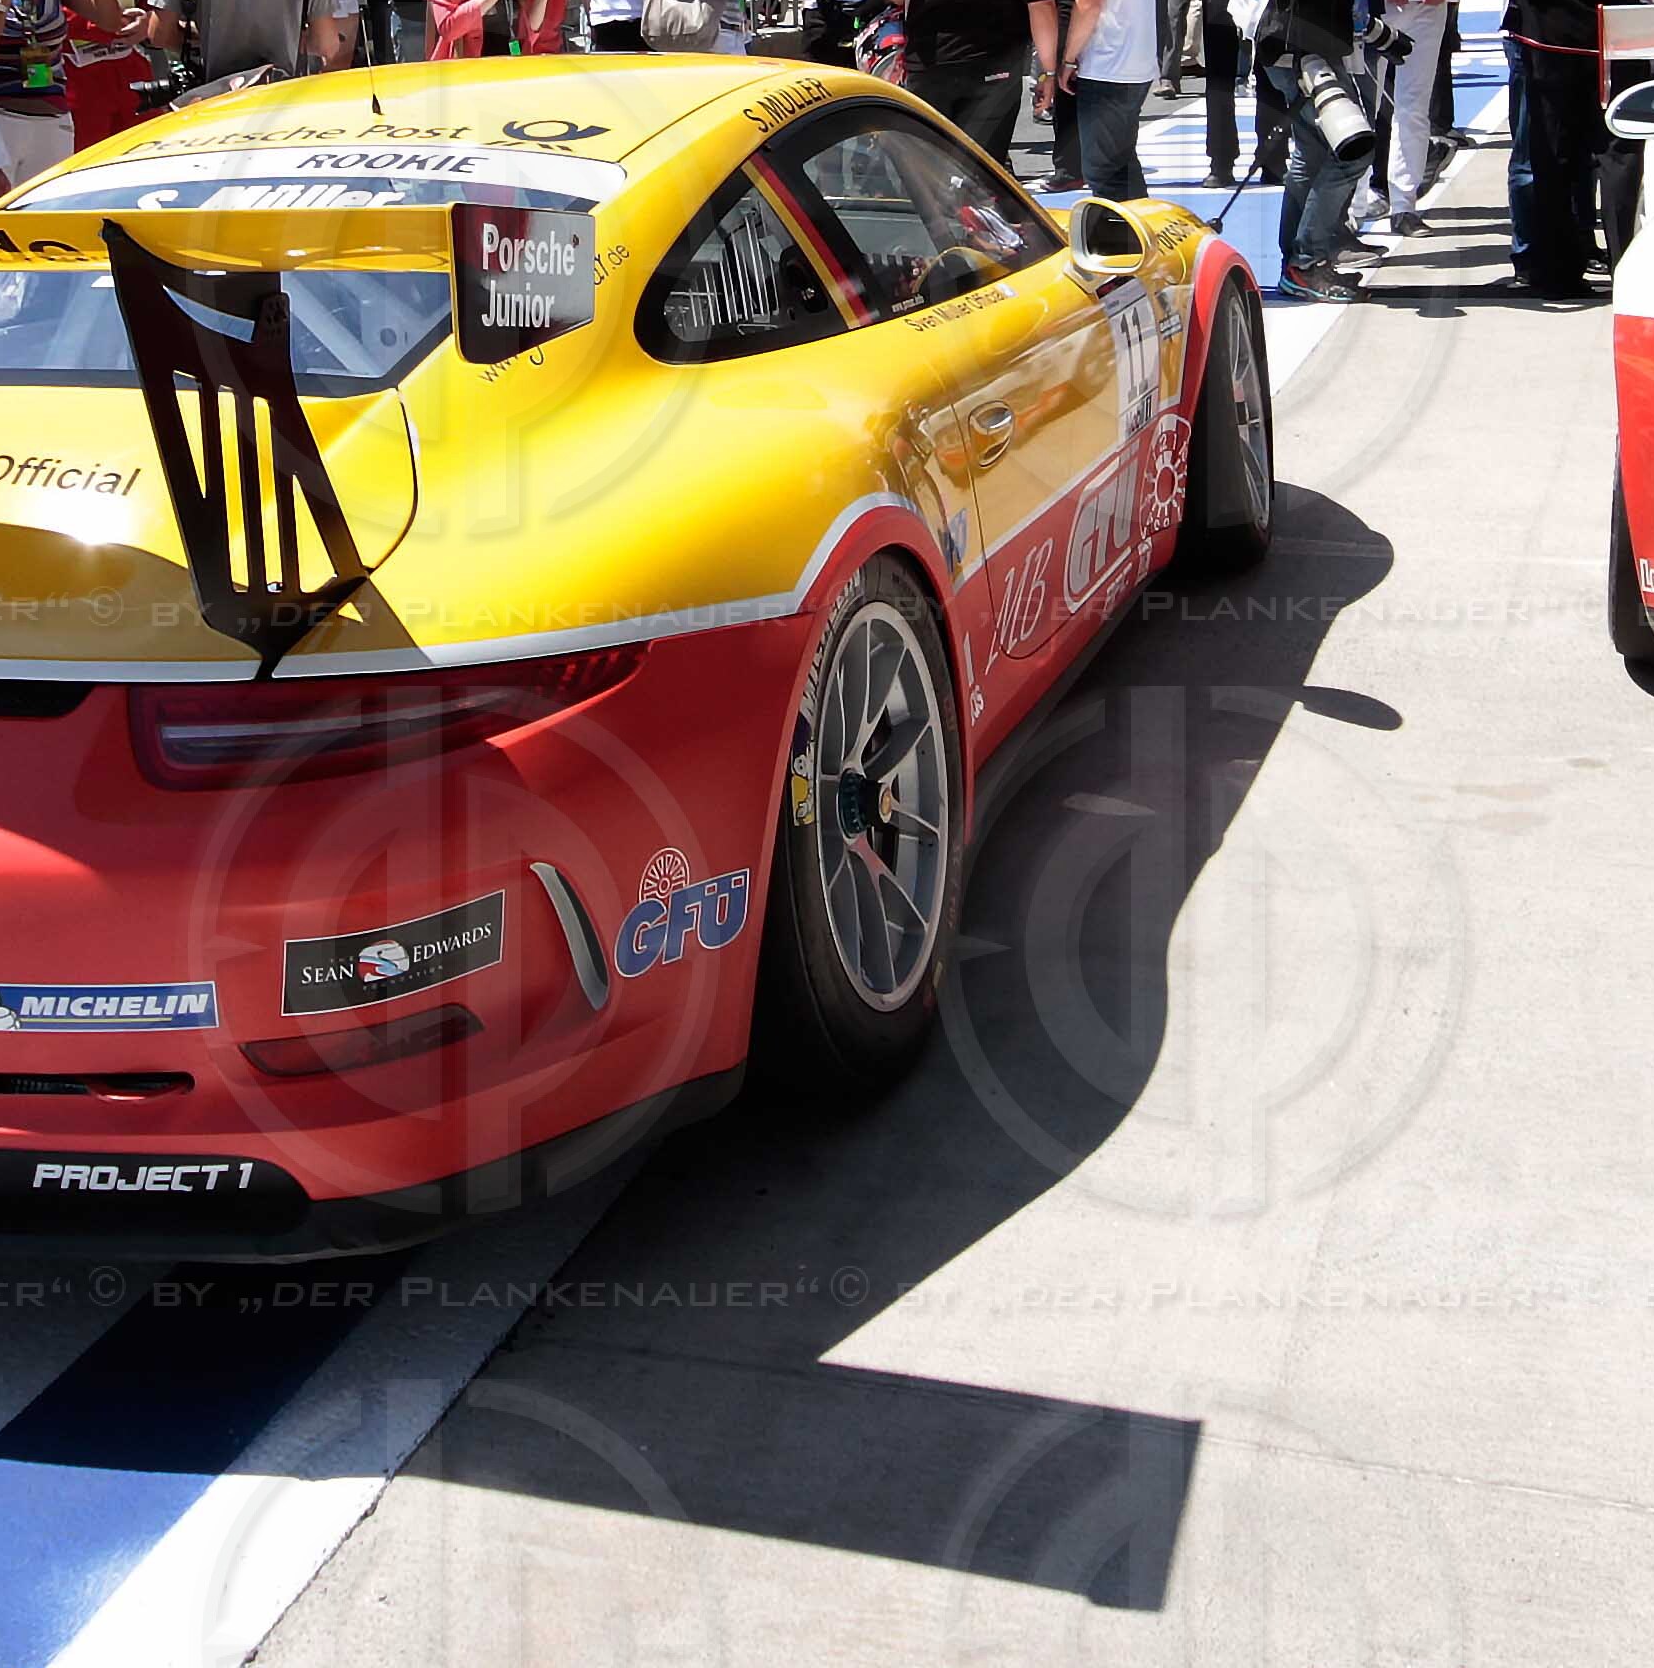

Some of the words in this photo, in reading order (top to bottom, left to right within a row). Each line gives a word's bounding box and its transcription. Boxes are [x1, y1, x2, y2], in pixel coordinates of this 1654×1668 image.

[125, 123, 346, 156] Deutsche
[355, 123, 475, 141] Post
[296, 152, 491, 174] ROOKIE
[482, 222, 576, 277] Porsche
[481, 279, 556, 329] Junior
[1121, 305, 1148, 404] 11
[300, 962, 355, 985] SEAN
[412, 923, 493, 964] EDWARDS
[20, 992, 210, 1017] MICHELIN
[33, 1163, 229, 1193] PROJECT
[236, 1162, 254, 1189] 1
